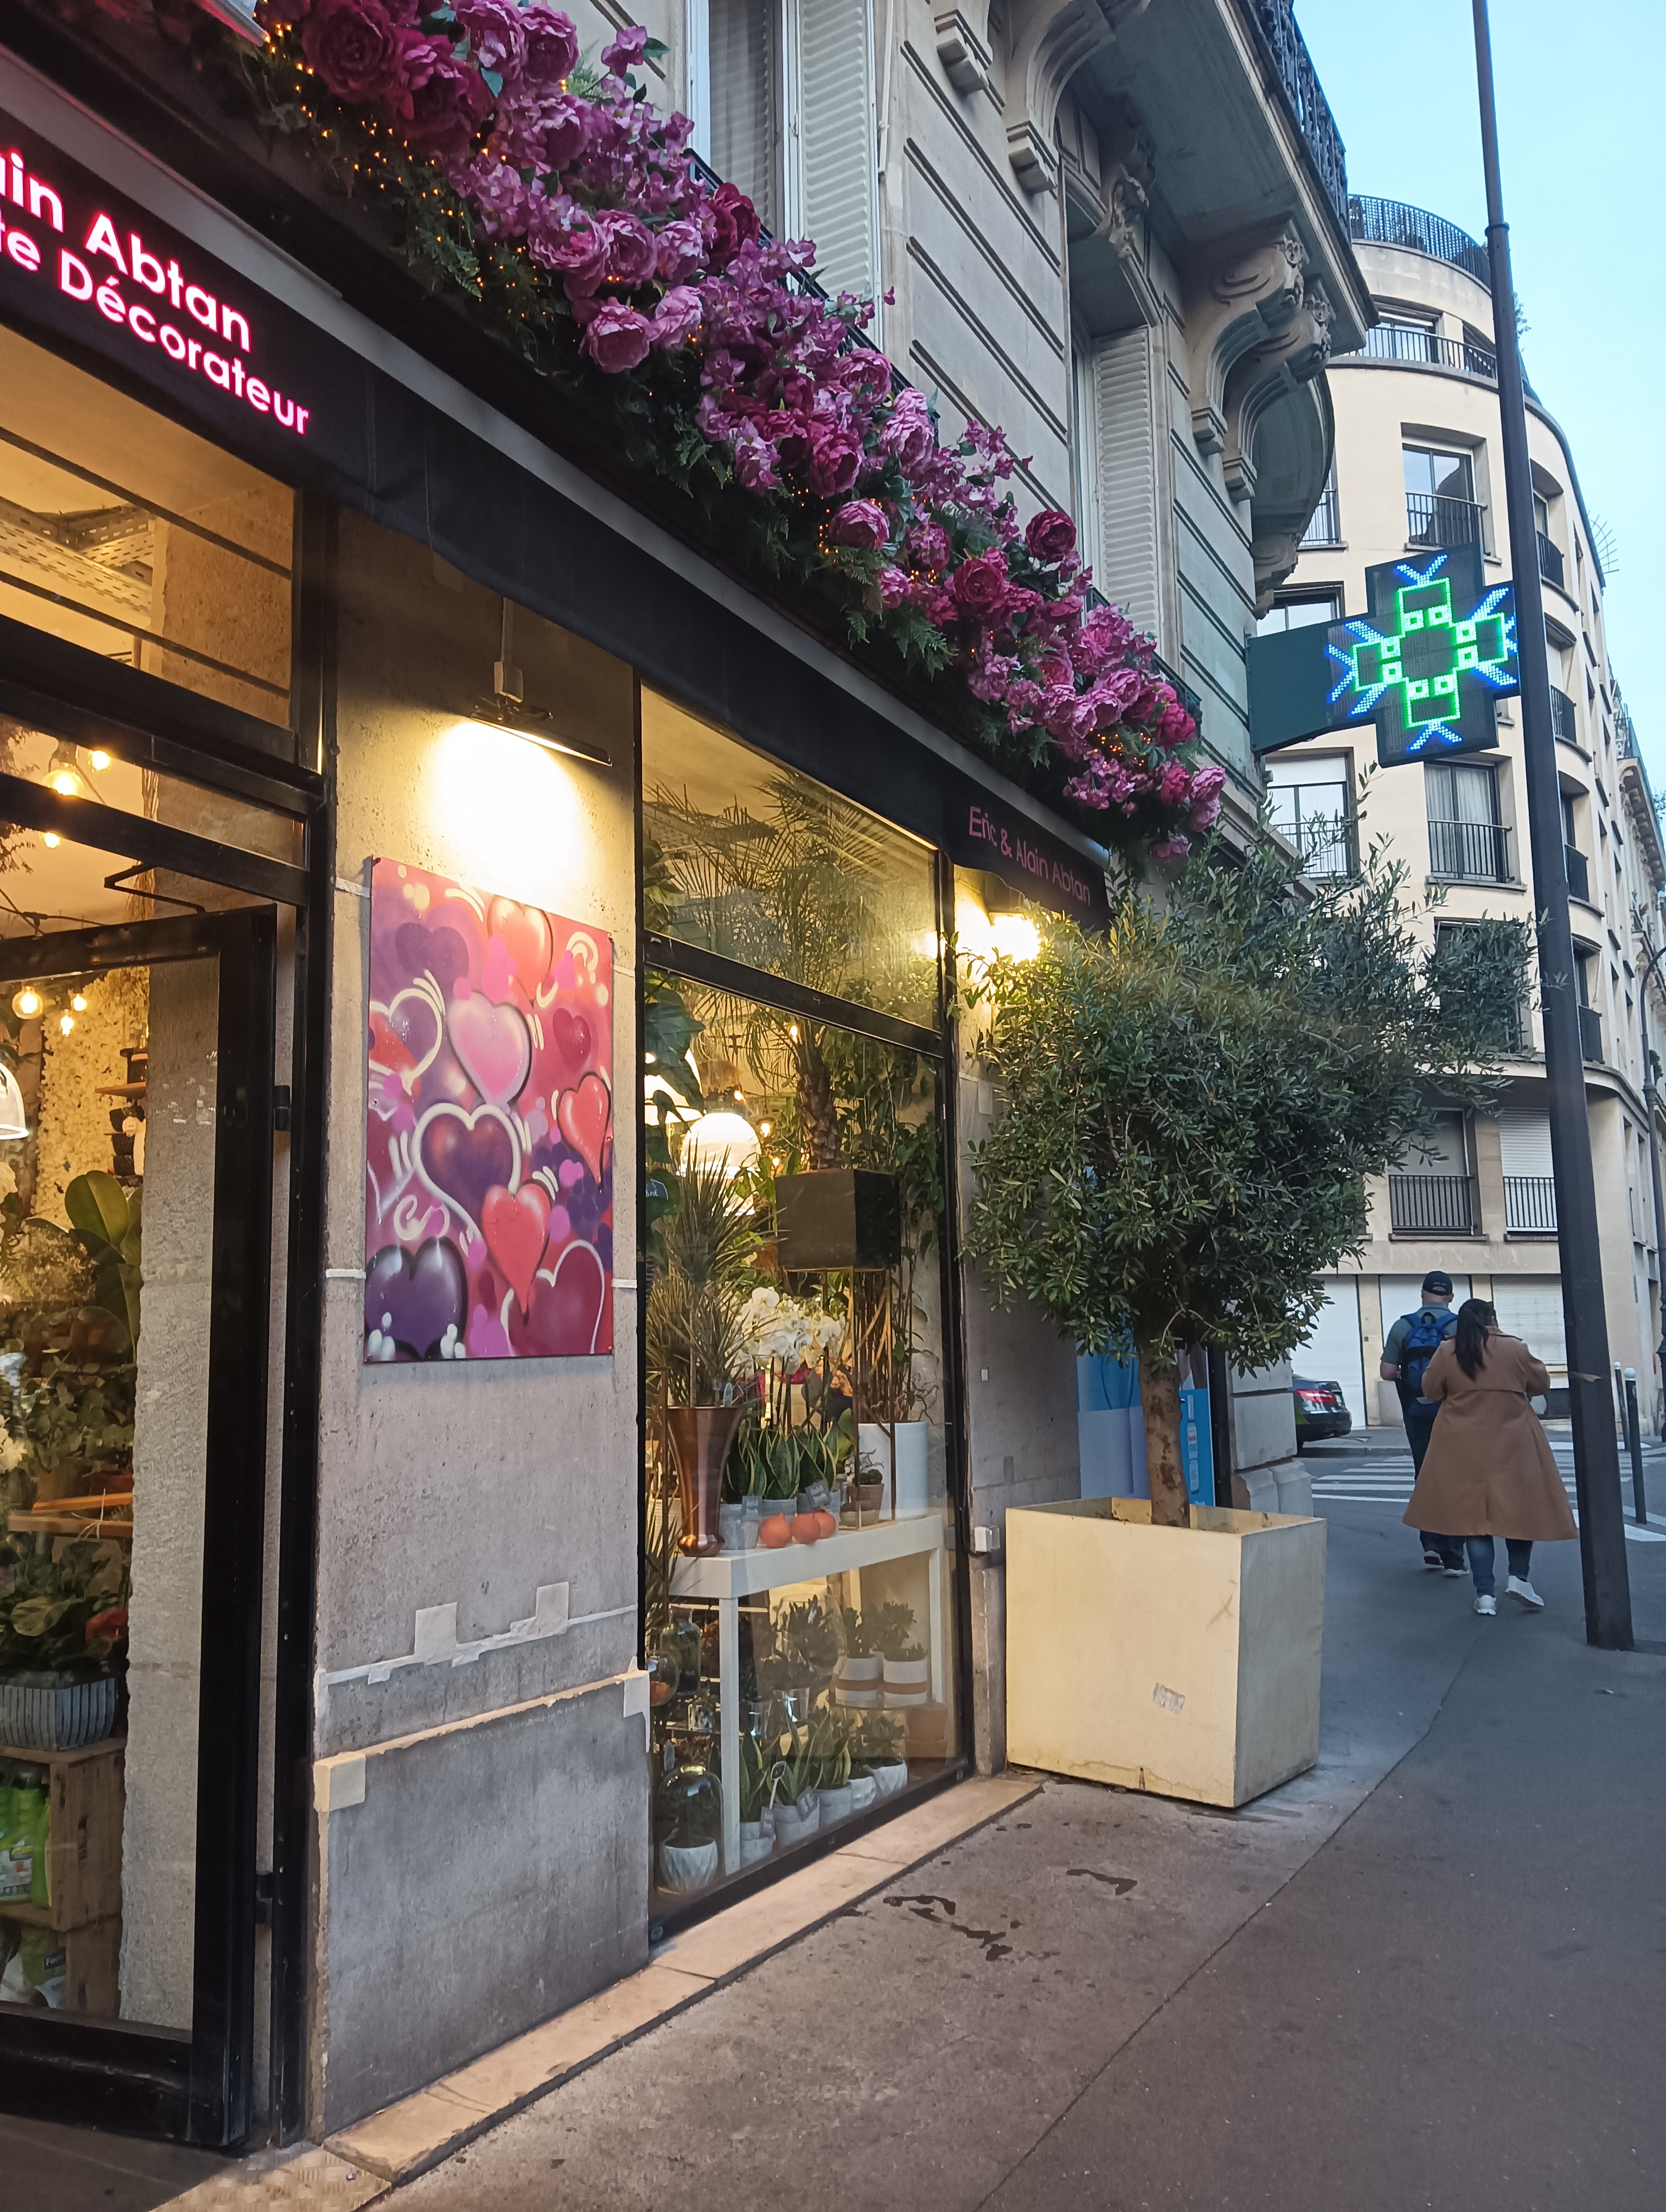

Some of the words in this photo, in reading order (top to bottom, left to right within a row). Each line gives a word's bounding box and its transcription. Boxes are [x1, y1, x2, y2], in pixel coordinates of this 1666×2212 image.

[0, 152, 64, 233] in
[85, 214, 251, 352] Abtan
[59, 248, 309, 434] Décorateur
[969, 806, 997, 847] Eric
[1000, 828, 1013, 858] &
[1016, 837, 1049, 879] Alain
[1053, 861, 1091, 905] Abtan
